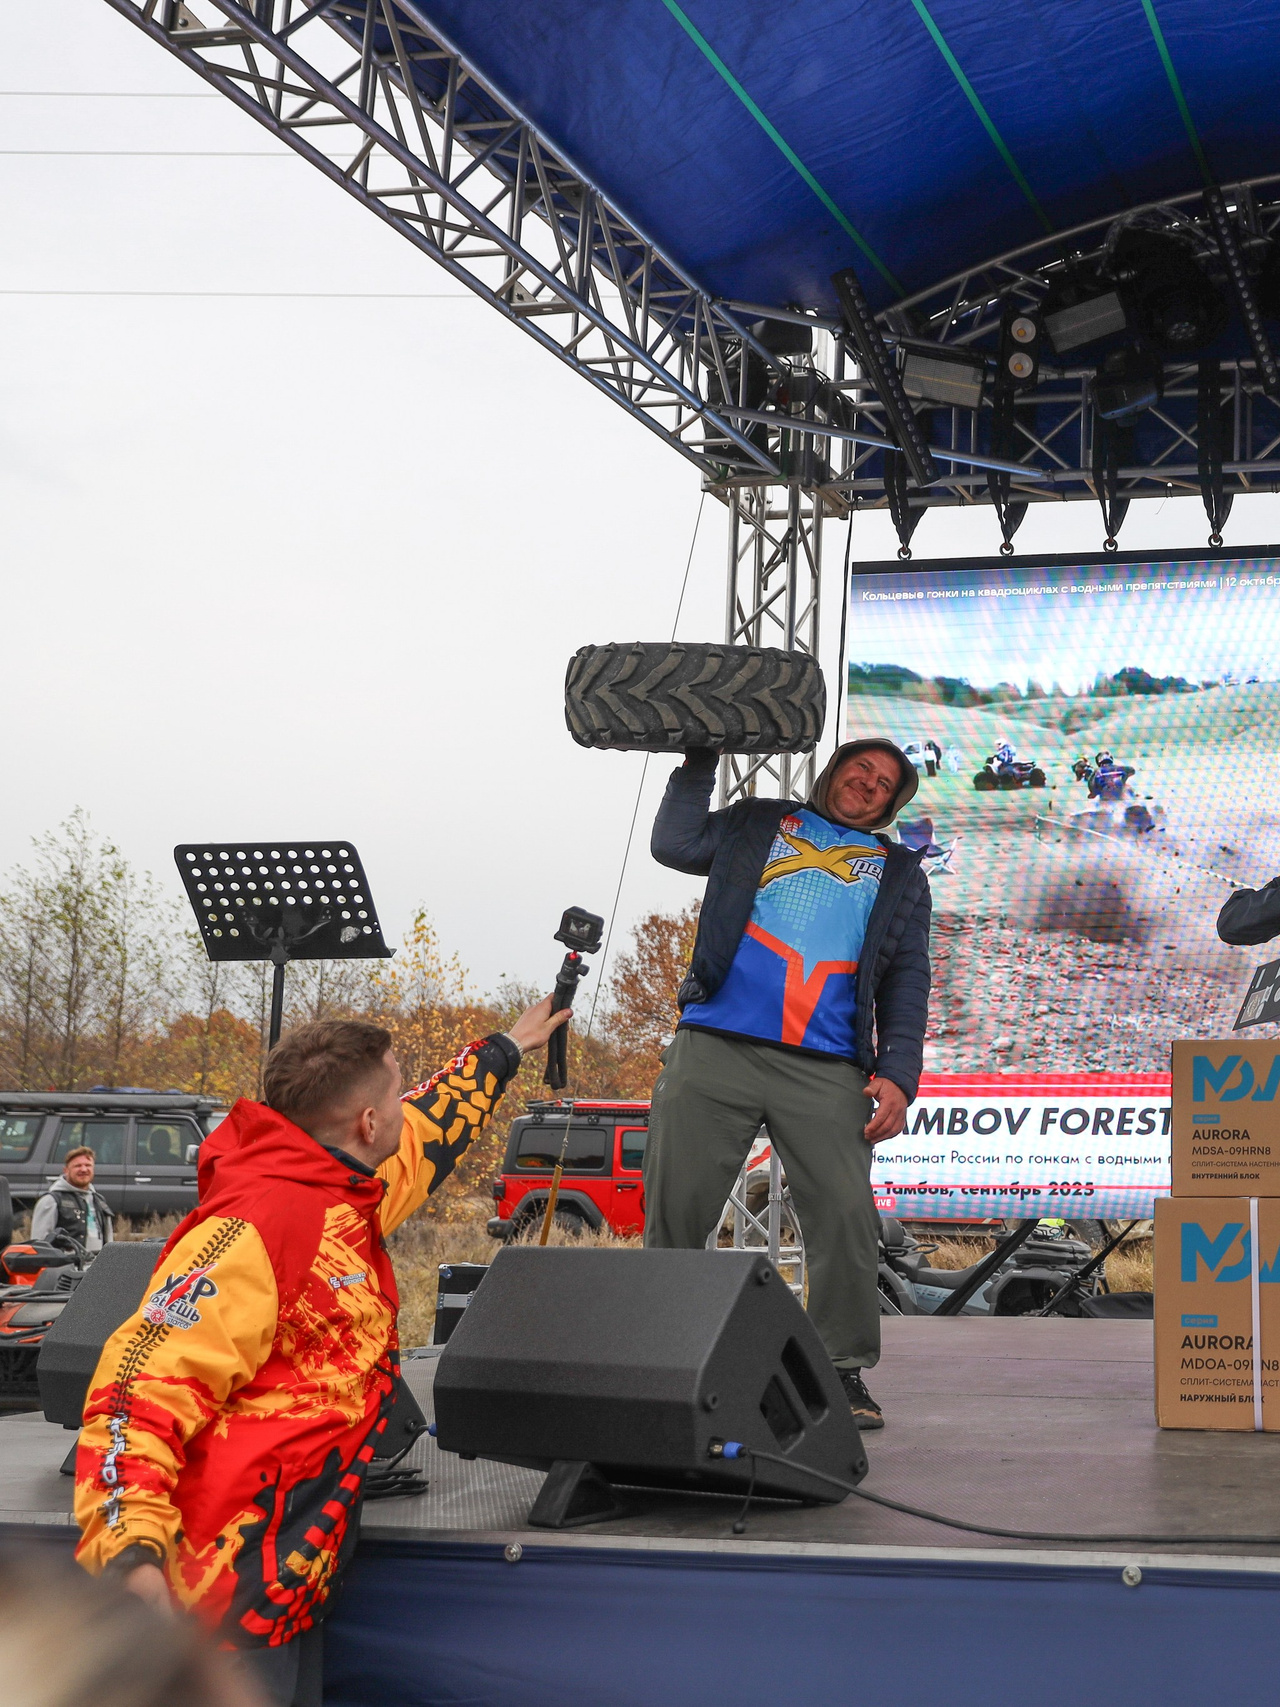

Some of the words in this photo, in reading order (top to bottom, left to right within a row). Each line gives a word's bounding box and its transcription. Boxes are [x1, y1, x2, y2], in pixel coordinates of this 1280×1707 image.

[862, 591, 924, 602] Кольцевые
[926, 590, 959, 599] гонки
[961, 590, 976, 598] на
[978, 586, 1059, 599] квадроциклах
[1060, 586, 1068, 594] с
[1070, 583, 1124, 595] водными
[1125, 579, 1217, 592] препятствиями
[1225, 577, 1237, 587] 12
[1040, 1107, 1171, 1136] FOREST
[1192, 1129, 1251, 1140] AURORA
[1192, 1146, 1271, 1156] MDSA-09HRN8
[951, 1151, 1000, 1164] России
[1005, 1155, 1023, 1164] по
[1028, 1155, 1080, 1164] гонкам
[1085, 1155, 1092, 1164] с
[1098, 1155, 1162, 1165] водными
[1191, 1172, 1239, 1180] ВНУТРЕННИЙ
[1048, 1181, 1095, 1196] 2025
[875, 1199, 892, 1207] IVE
[1184, 1317, 1214, 1325] серия
[1180, 1378, 1254, 1387] СПЛИТ-СИСТЕМА
[1180, 1393, 1236, 1403] НАРУЖНЫЙ
